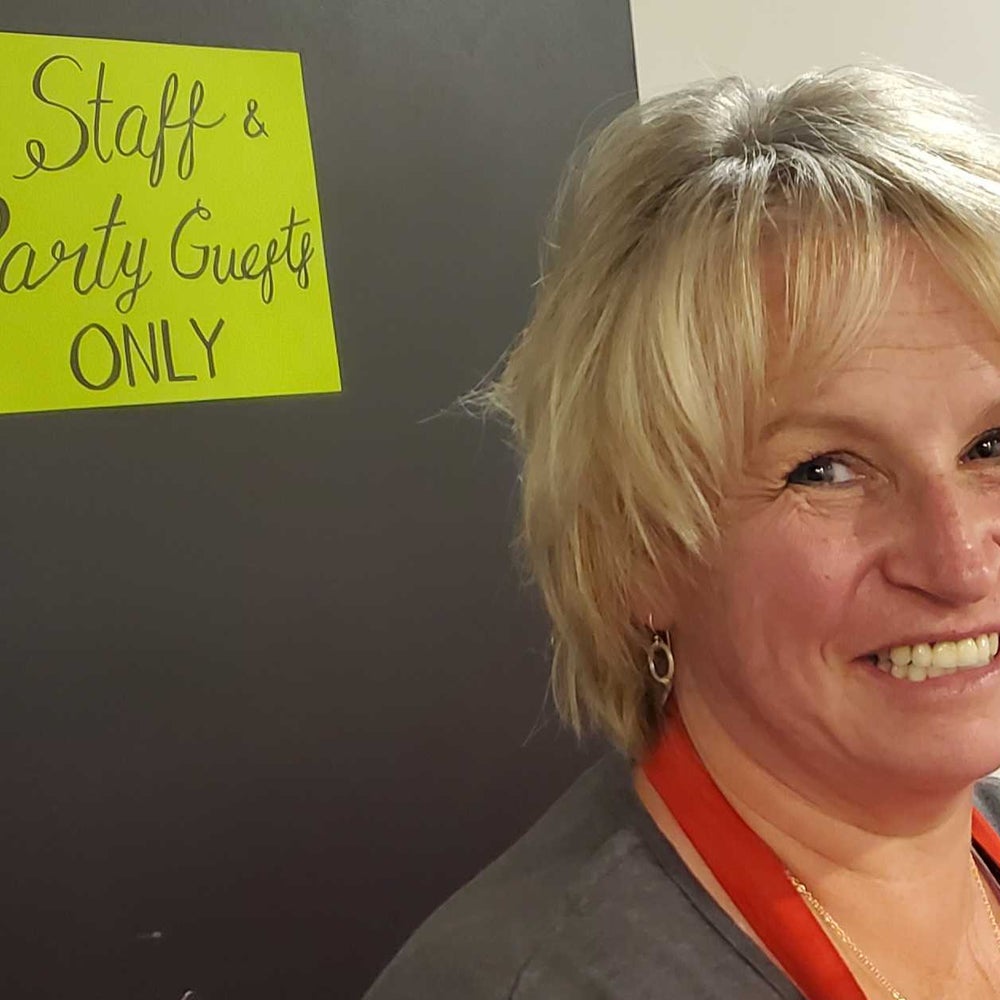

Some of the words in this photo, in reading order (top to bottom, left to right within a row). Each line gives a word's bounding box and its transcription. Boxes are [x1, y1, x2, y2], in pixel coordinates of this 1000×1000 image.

[13, 54, 226, 188] Staff
[243, 98, 269, 138] &
[69, 317, 225, 391] ONLY
